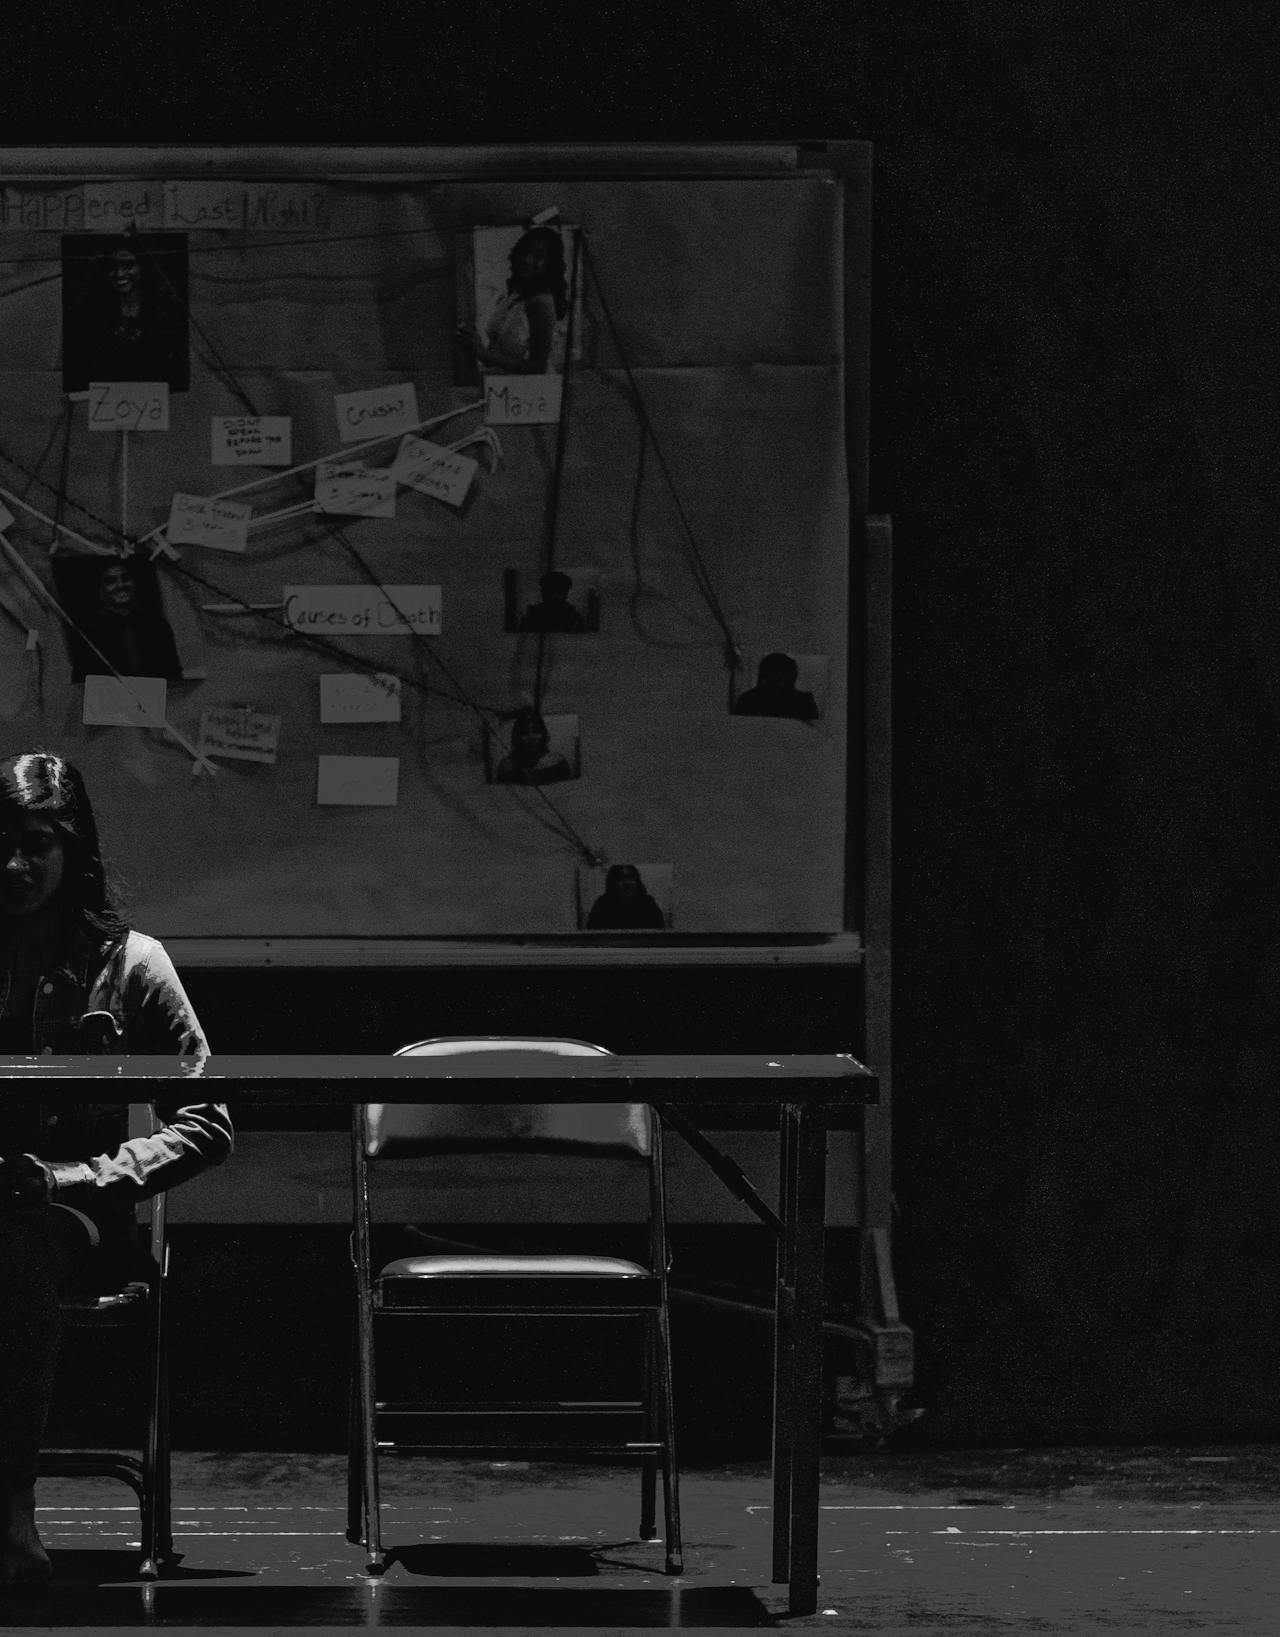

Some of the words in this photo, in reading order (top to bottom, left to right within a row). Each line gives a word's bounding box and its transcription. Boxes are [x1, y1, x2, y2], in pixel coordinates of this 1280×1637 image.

[168, 188, 239, 224] Last
[91, 386, 162, 429] Zoya
[487, 386, 547, 419] Maya
[283, 593, 348, 627] Causes
[351, 607, 370, 627] of
